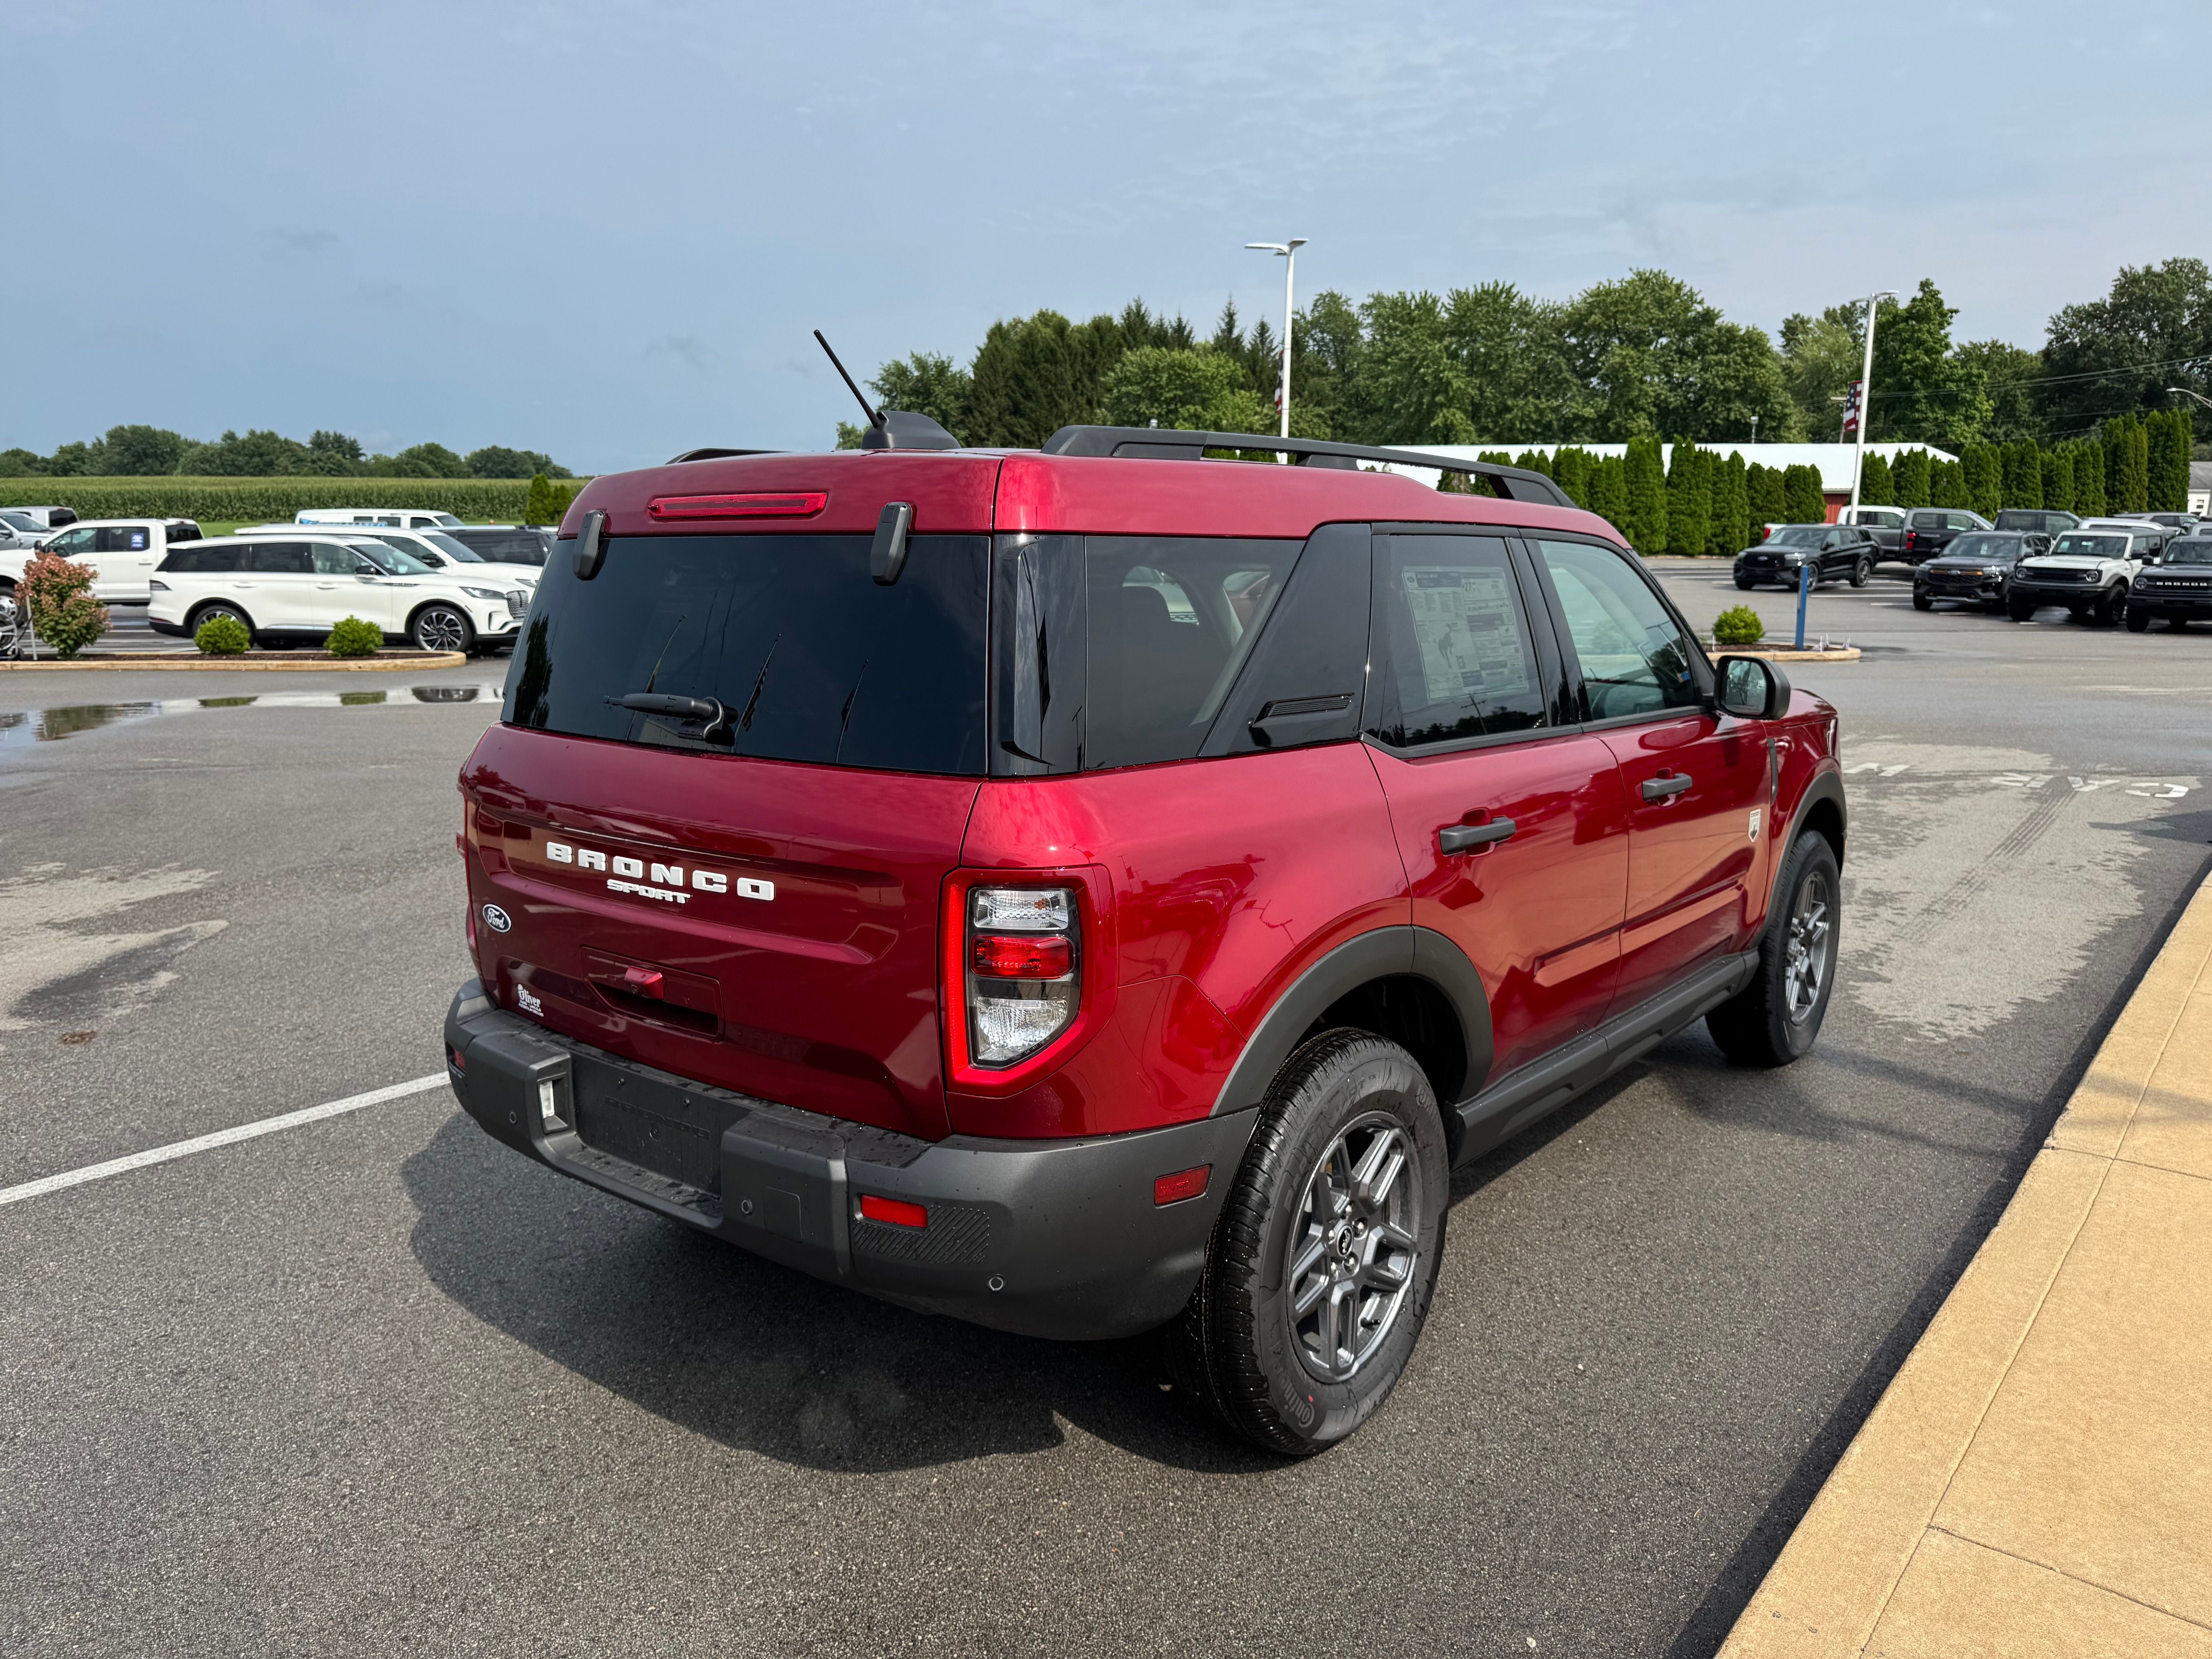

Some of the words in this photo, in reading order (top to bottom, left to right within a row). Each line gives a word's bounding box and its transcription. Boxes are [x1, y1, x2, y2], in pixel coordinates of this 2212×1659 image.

[546, 841, 775, 902] BRONCO
[606, 879, 692, 904] SPORT
[486, 907, 506, 929] Ford
[518, 988, 541, 1007] Oliver
